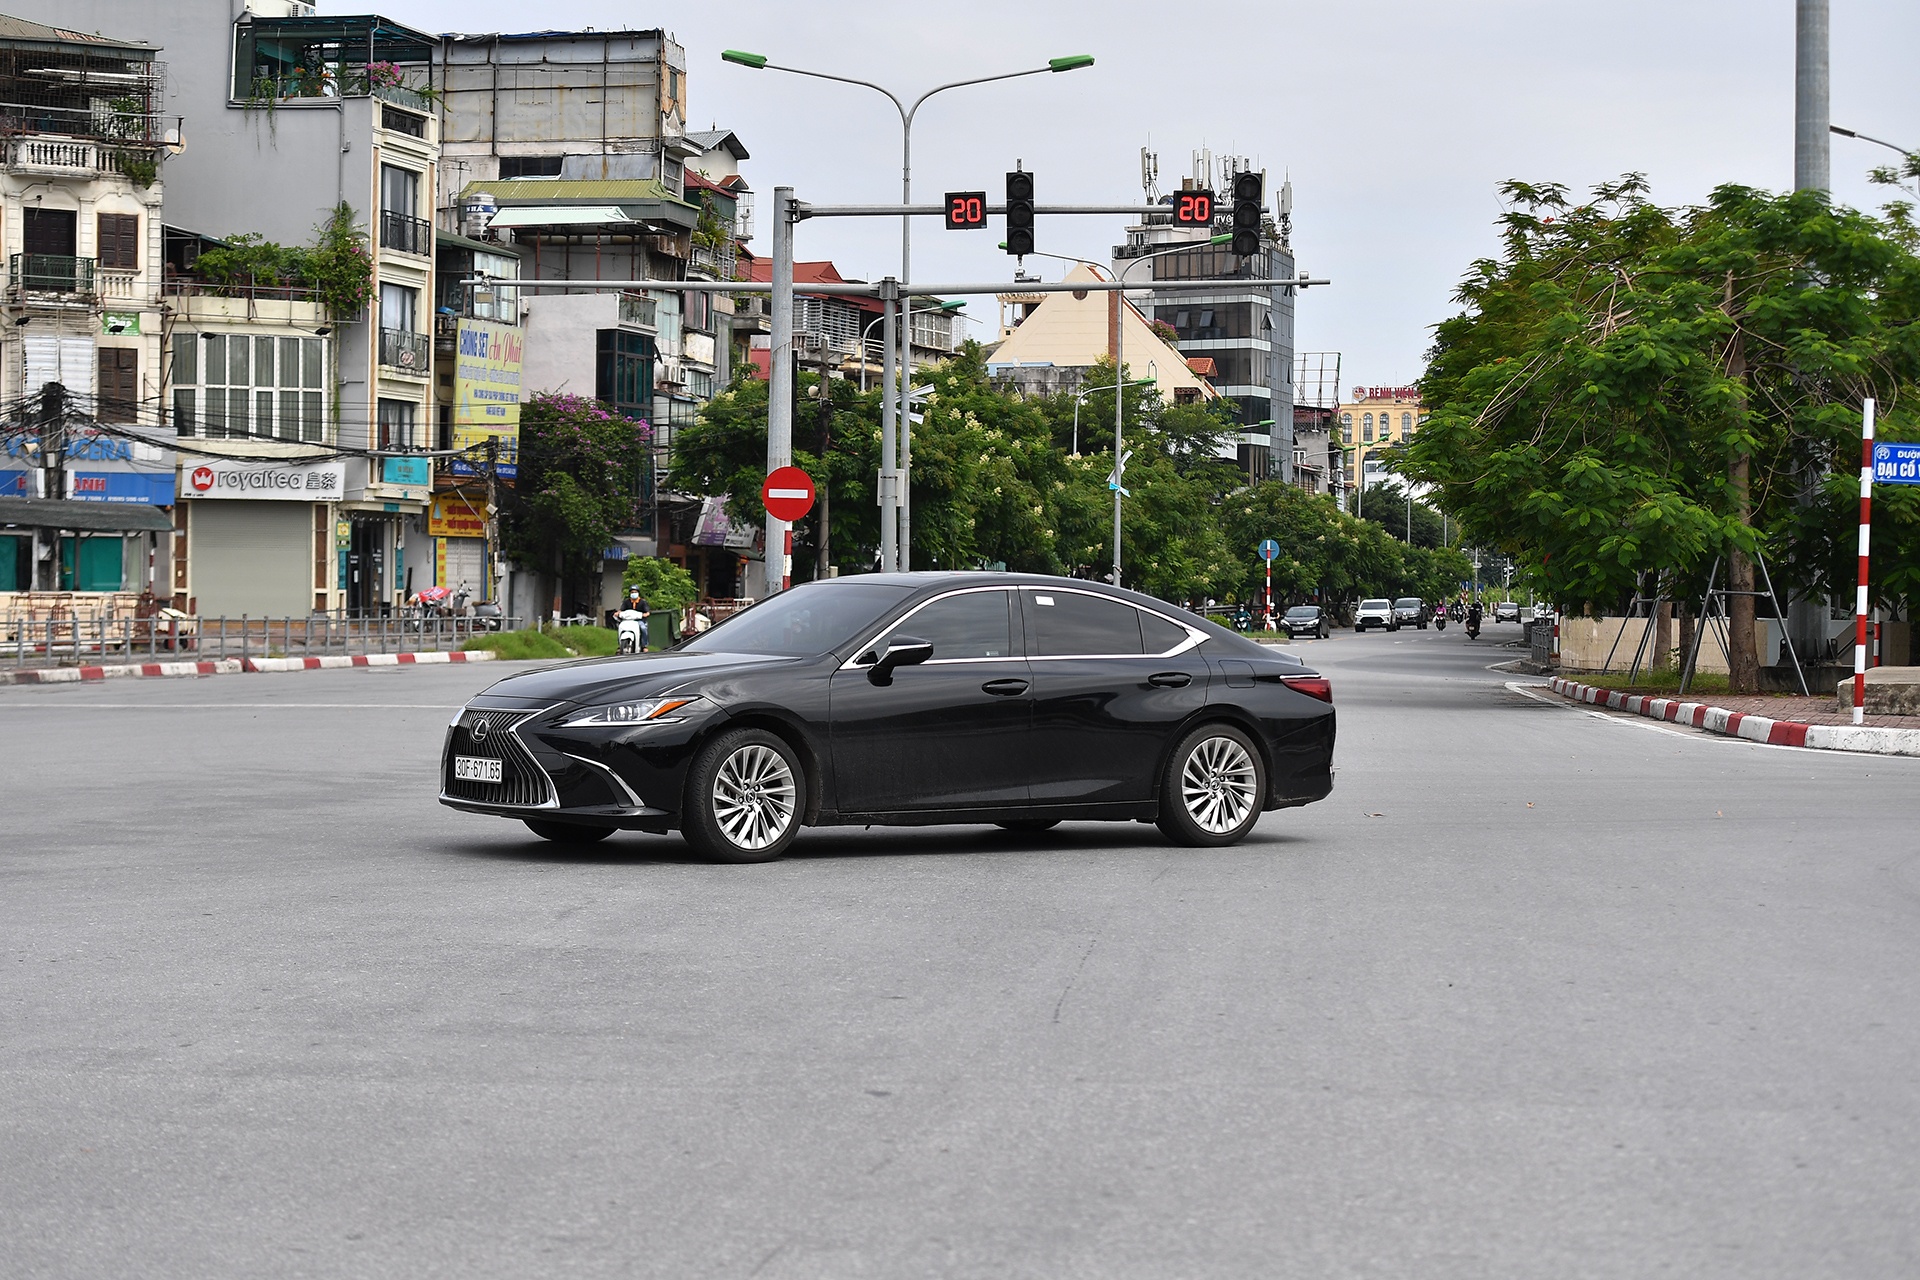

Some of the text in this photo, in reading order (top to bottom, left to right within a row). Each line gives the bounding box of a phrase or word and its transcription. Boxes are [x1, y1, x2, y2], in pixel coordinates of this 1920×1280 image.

[951, 198, 982, 223] 20
[1179, 195, 1210, 222] 20
[503, 332, 523, 367] Phát
[1369, 385, 1392, 400] BỆNH
[217, 470, 303, 491] royaltea
[306, 471, 337, 490] 皇茶
[1877, 462, 1898, 479] ĐẠI
[456, 758, 501, 780] 30F-671.65
